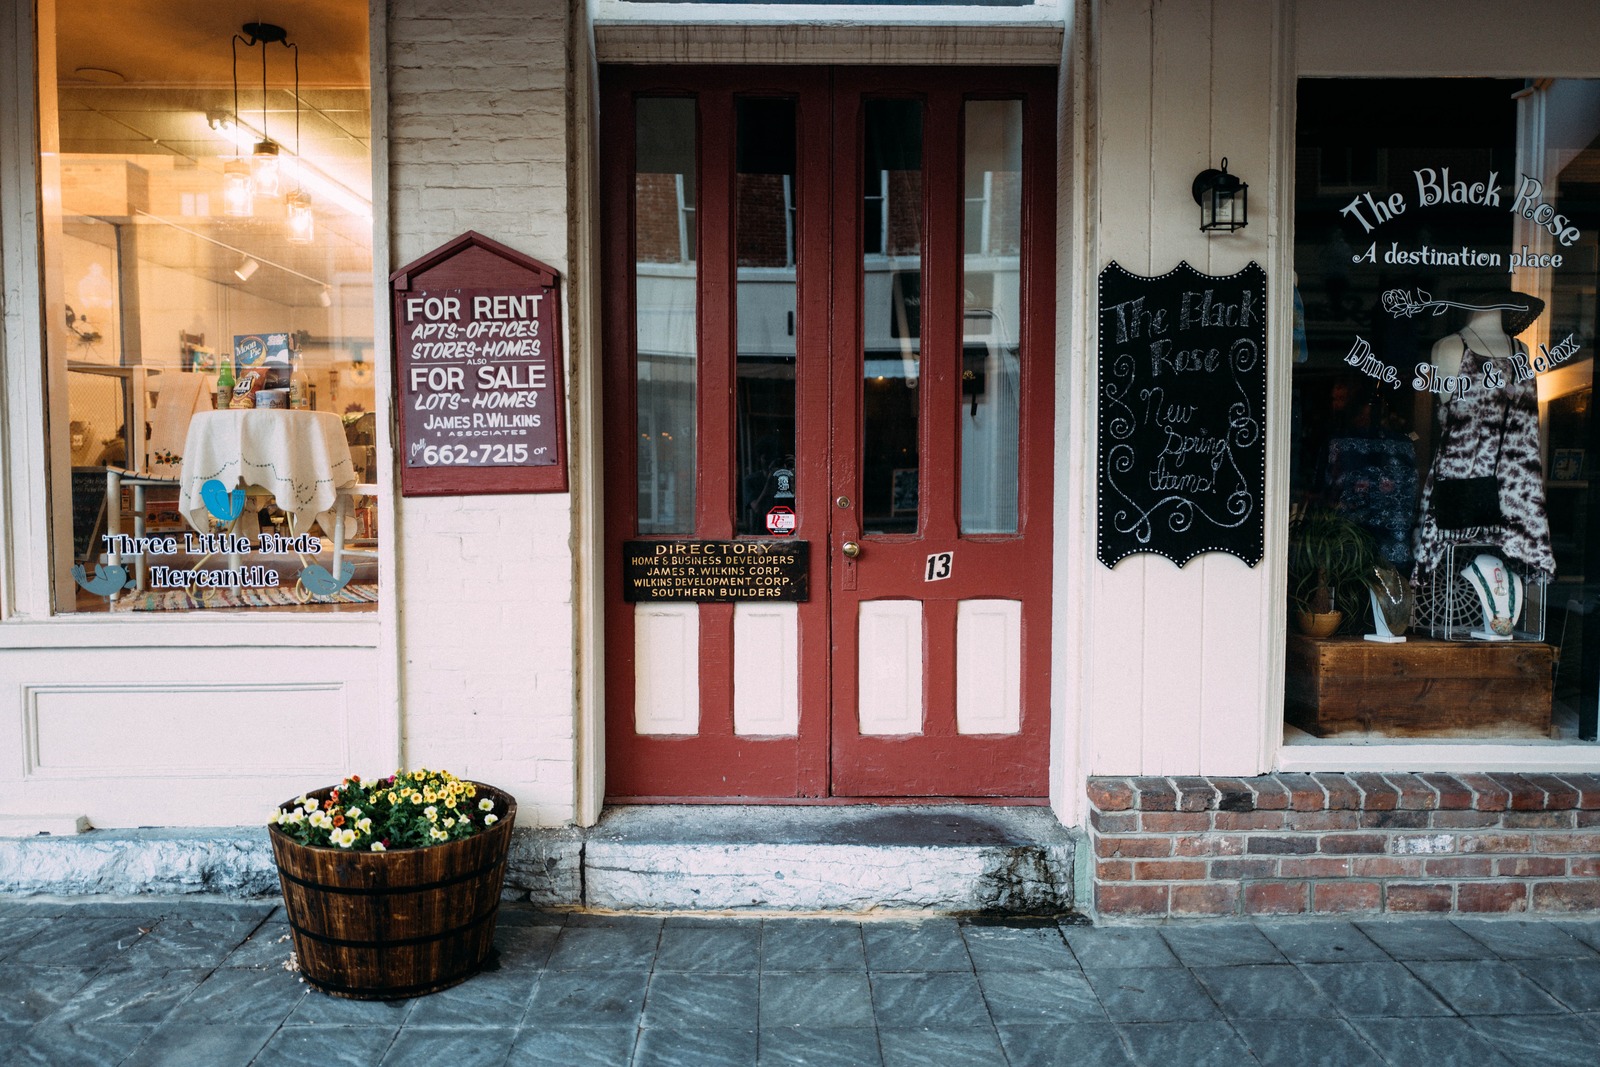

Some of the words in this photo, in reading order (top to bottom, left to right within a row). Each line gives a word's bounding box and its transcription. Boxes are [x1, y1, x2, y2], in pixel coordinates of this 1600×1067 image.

[1339, 191, 1407, 234] The
[1413, 166, 1502, 208] Black
[1510, 173, 1581, 247] Rose
[1352, 241, 1377, 263] A
[1384, 242, 1501, 267] destination
[1508, 245, 1563, 274] place
[407, 297, 460, 321] FOR
[474, 295, 543, 319] RENT
[1101, 296, 1169, 344] The
[1180, 289, 1258, 330] Black
[236, 341, 257, 356] Moon
[1150, 338, 1220, 377] Rose
[411, 367, 464, 391] FOR
[478, 365, 546, 389] SALE
[1344, 335, 1402, 390] Dine,
[1412, 362, 1471, 402] Shop
[1483, 361, 1505, 389] &
[1507, 333, 1581, 383] Relax
[1140, 387, 1198, 427] New
[424, 414, 470, 430] JAMES
[448, 429, 527, 437] ASSOCIATES
[534, 446, 547, 455] or
[1157, 425, 1228, 470] Spring
[1149, 456, 1217, 494] Items!
[102, 533, 177, 555] Three
[185, 533, 251, 555] Little
[258, 533, 322, 555] Birds
[655, 544, 773, 555] DIRECTORY
[632, 557, 659, 566] HOME
[662, 557, 669, 565] &
[671, 556, 722, 565] BUSINESS
[725, 556, 795, 565] DEVELOPERS
[647, 568, 685, 576] JAMES
[749, 567, 783, 575] CORP.
[926, 553, 951, 580] 13
[151, 566, 279, 588] Mercantile
[634, 578, 672, 587] WILKINS
[675, 577, 751, 586] DEVELOPMENT
[755, 577, 794, 586] CORP.
[651, 588, 715, 597] SOUTHERN
[719, 587, 781, 597] BUILDERS
